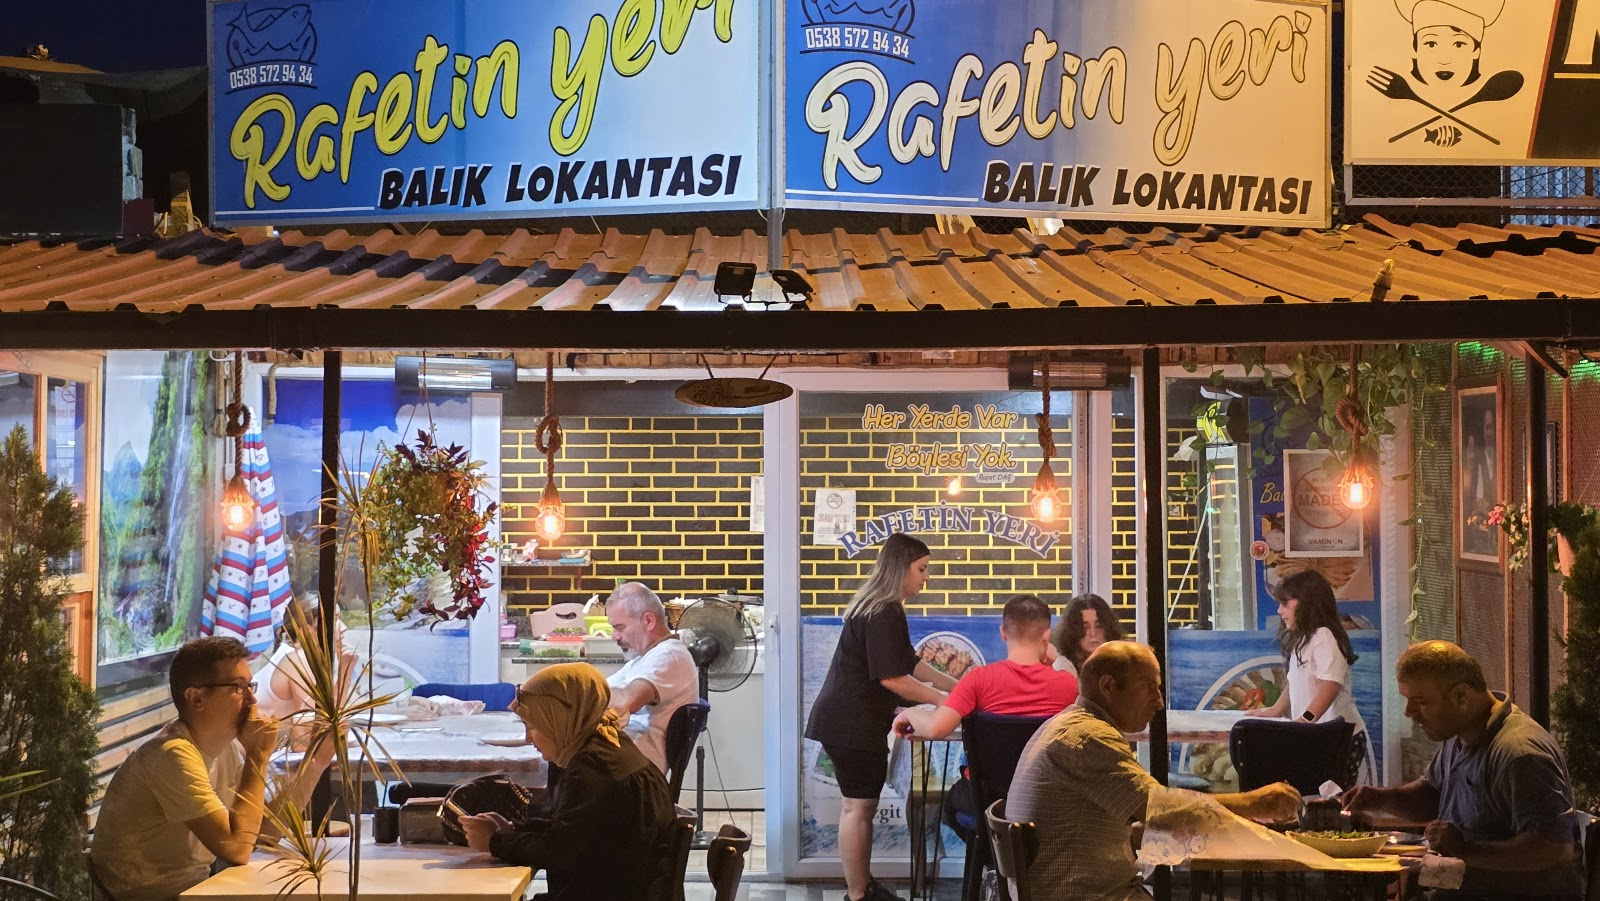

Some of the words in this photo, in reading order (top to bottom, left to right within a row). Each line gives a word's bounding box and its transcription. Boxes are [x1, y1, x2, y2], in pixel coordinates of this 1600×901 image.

[805, 27, 840, 49] 0538
[845, 27, 869, 49] 572
[872, 30, 889, 52] 94
[892, 35, 909, 57] 34
[229, 66, 257, 89] 0538
[260, 64, 280, 83] 572
[282, 64, 296, 82] 94
[298, 65, 313, 84] 34
[804, 28, 1129, 190] Rafetin
[1152, 10, 1312, 166] yeri
[229, 34, 520, 209] Rafetin
[378, 164, 492, 210] BALIK
[504, 154, 742, 204] LOKANTASI
[982, 161, 1102, 208] BALIK
[1112, 168, 1312, 215] LOKANTASI
[862, 404, 905, 430] Her
[909, 404, 972, 430] Yerde
[975, 404, 1018, 430] Var
[886, 441, 968, 476] Böylesi
[972, 443, 1017, 469] Yok.
[839, 501, 975, 558] RAFETİN
[983, 511, 1061, 559] YERİ
